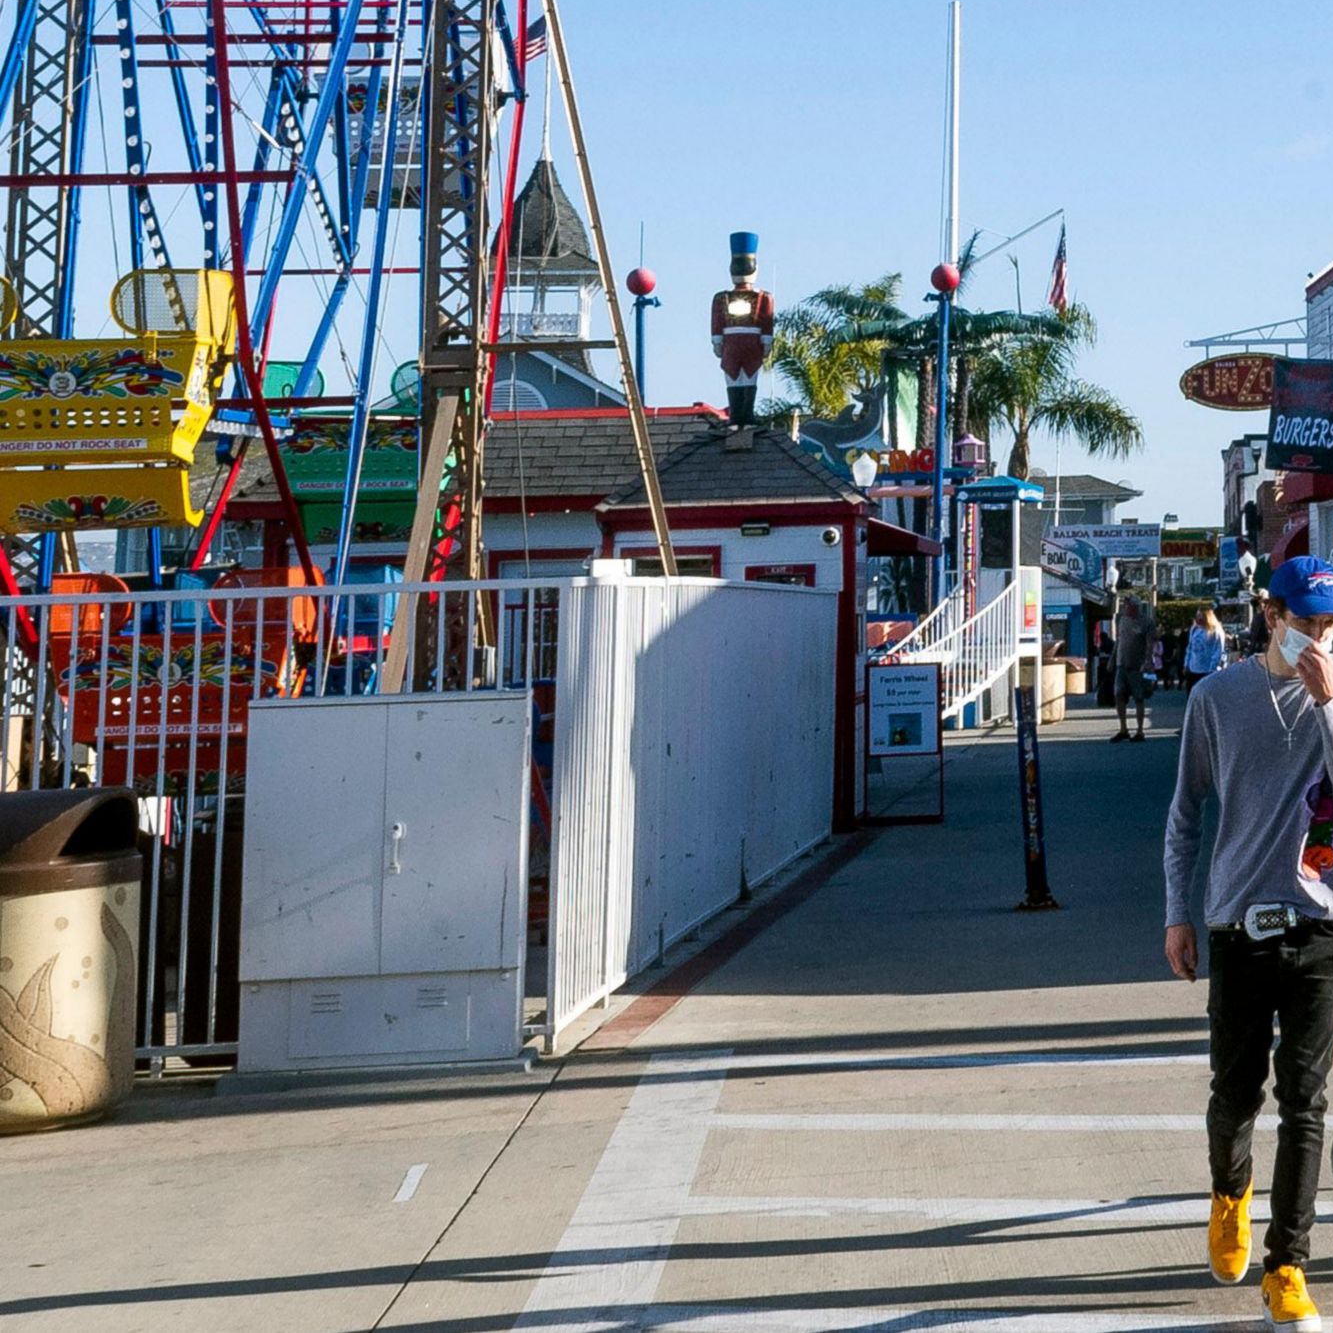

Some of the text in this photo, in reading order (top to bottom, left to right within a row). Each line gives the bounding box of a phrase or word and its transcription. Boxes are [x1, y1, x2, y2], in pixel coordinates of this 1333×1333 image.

[1187, 367, 1239, 398] FUN
[1237, 357, 1274, 403] ZO
[36, 442, 53, 450] DO
[55, 441, 78, 450] NOT
[80, 440, 111, 449] ROCK
[114, 439, 143, 448] SEAT
[1053, 529, 1160, 539] BALBOA BEACH TREATS
[1047, 552, 1068, 566] BOAT
[1067, 558, 1082, 571] CO.
[143, 725, 158, 734] DO
[183, 724, 212, 733] RCK
